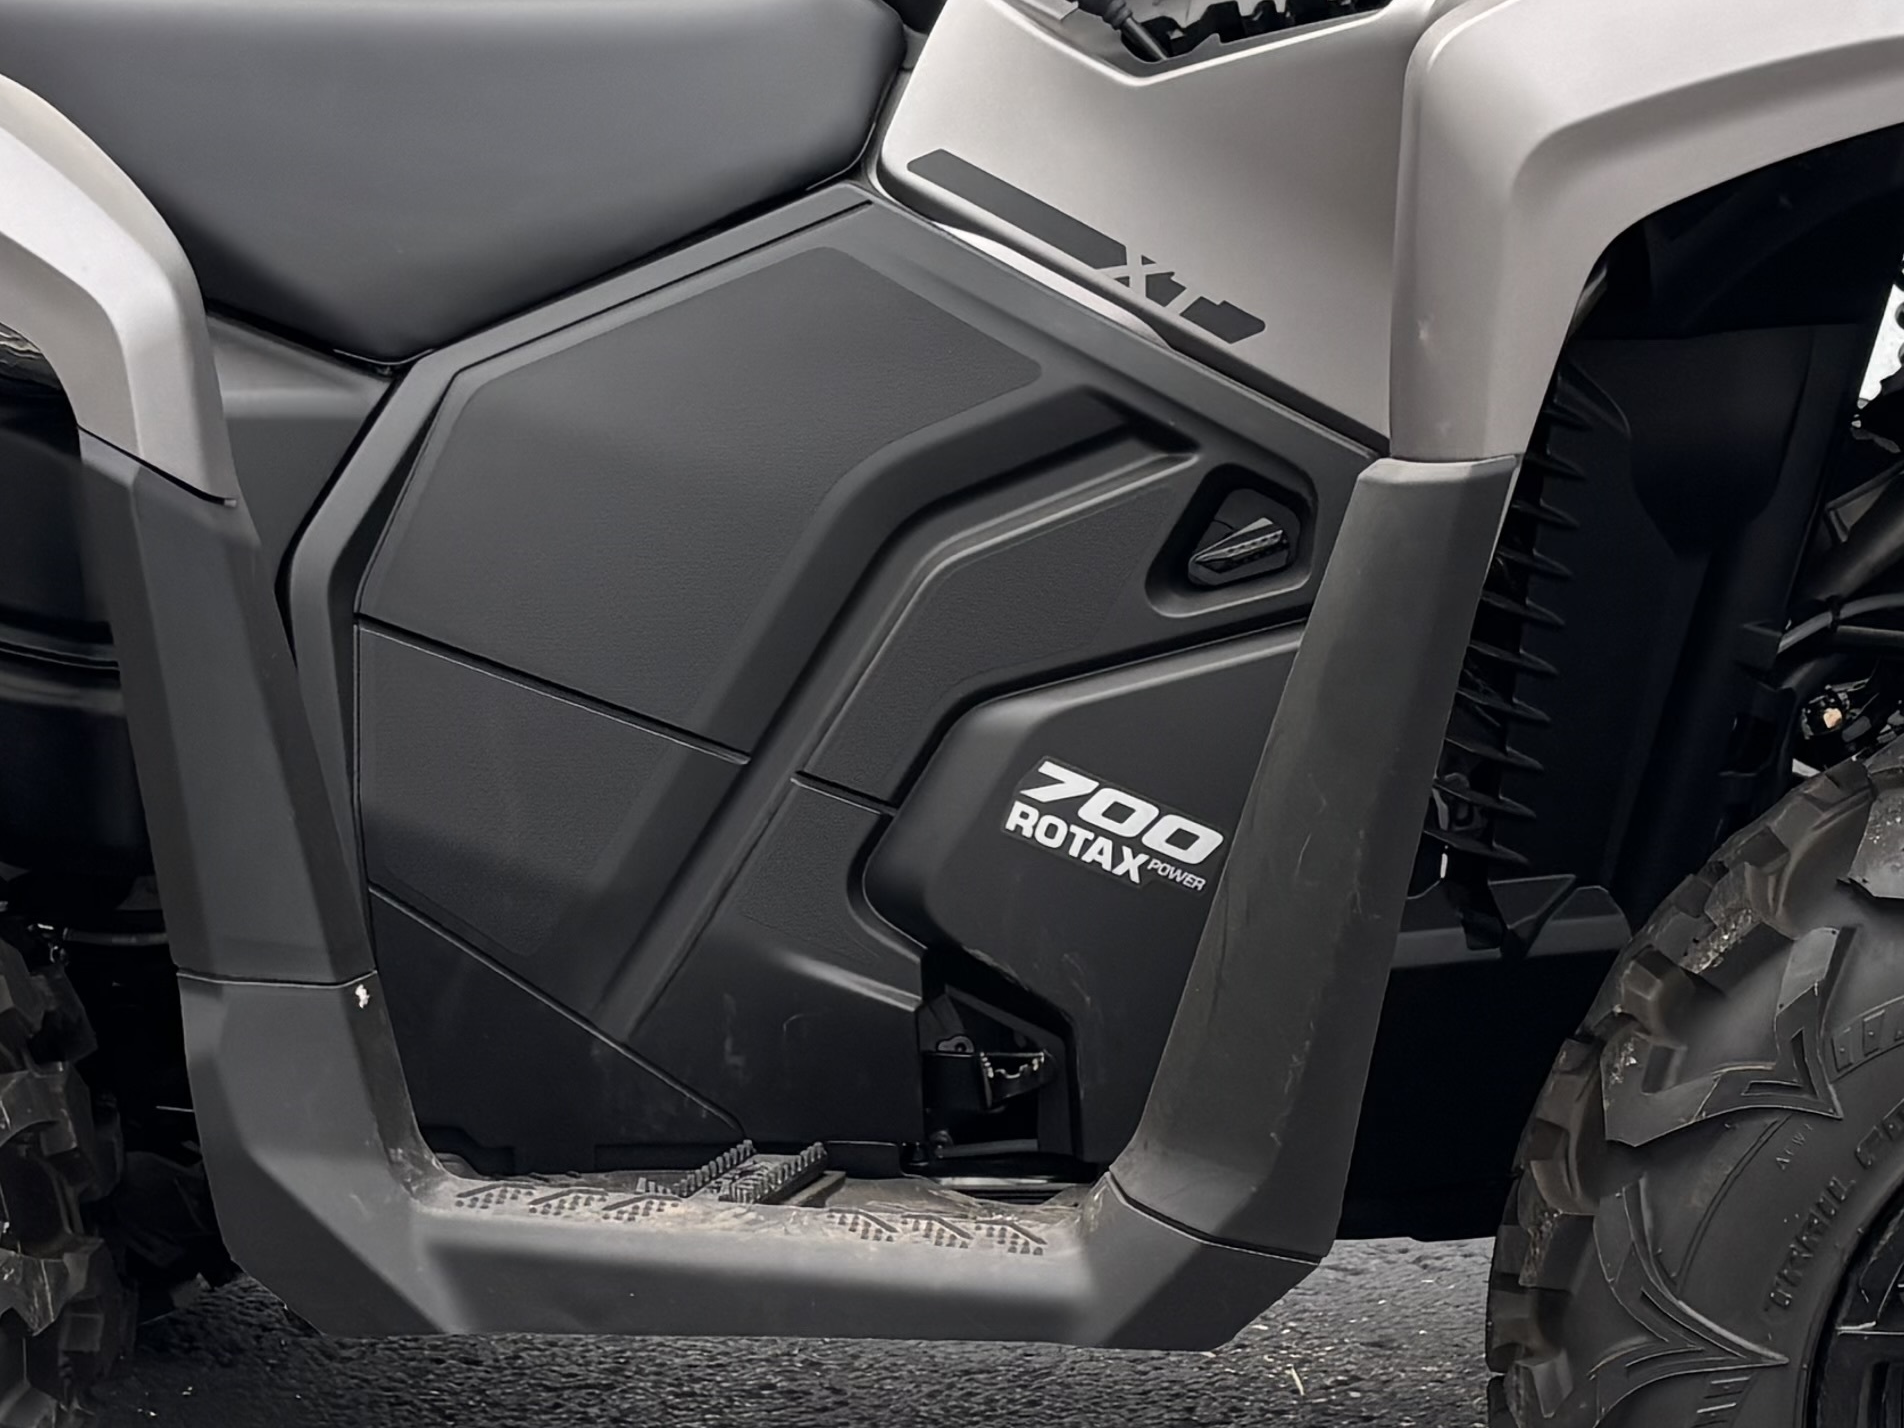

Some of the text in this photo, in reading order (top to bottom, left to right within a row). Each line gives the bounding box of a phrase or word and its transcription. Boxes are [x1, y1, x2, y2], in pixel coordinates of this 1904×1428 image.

[1005, 801, 1206, 892] ROTAX POWER
[1019, 760, 1224, 865] 700
